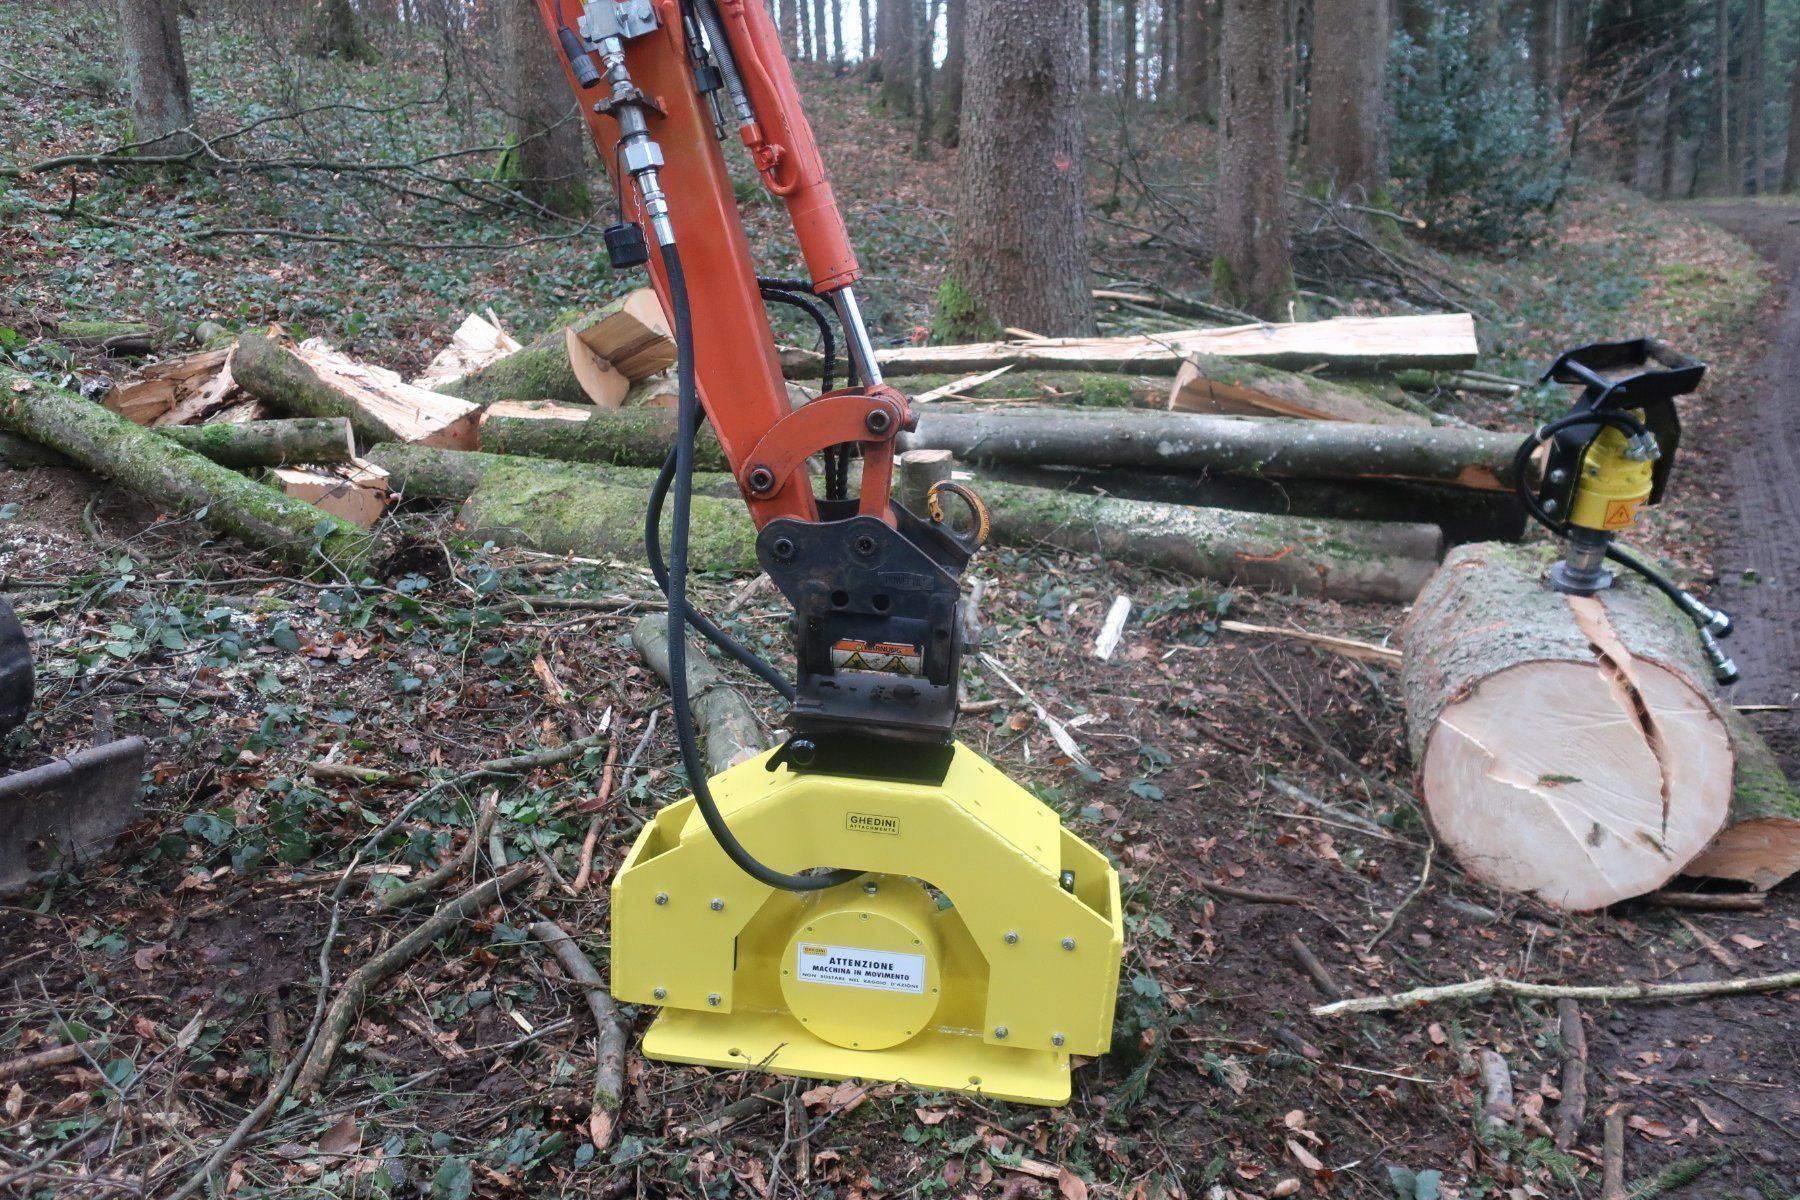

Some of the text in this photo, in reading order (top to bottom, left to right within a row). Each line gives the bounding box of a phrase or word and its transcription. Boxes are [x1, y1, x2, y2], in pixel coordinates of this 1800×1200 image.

[850, 815, 896, 828] GHEDINI
[829, 957, 894, 971] ATTENZIONE
[812, 965, 851, 975] MACCHINA
[865, 970, 910, 981] MOVIMENTO
